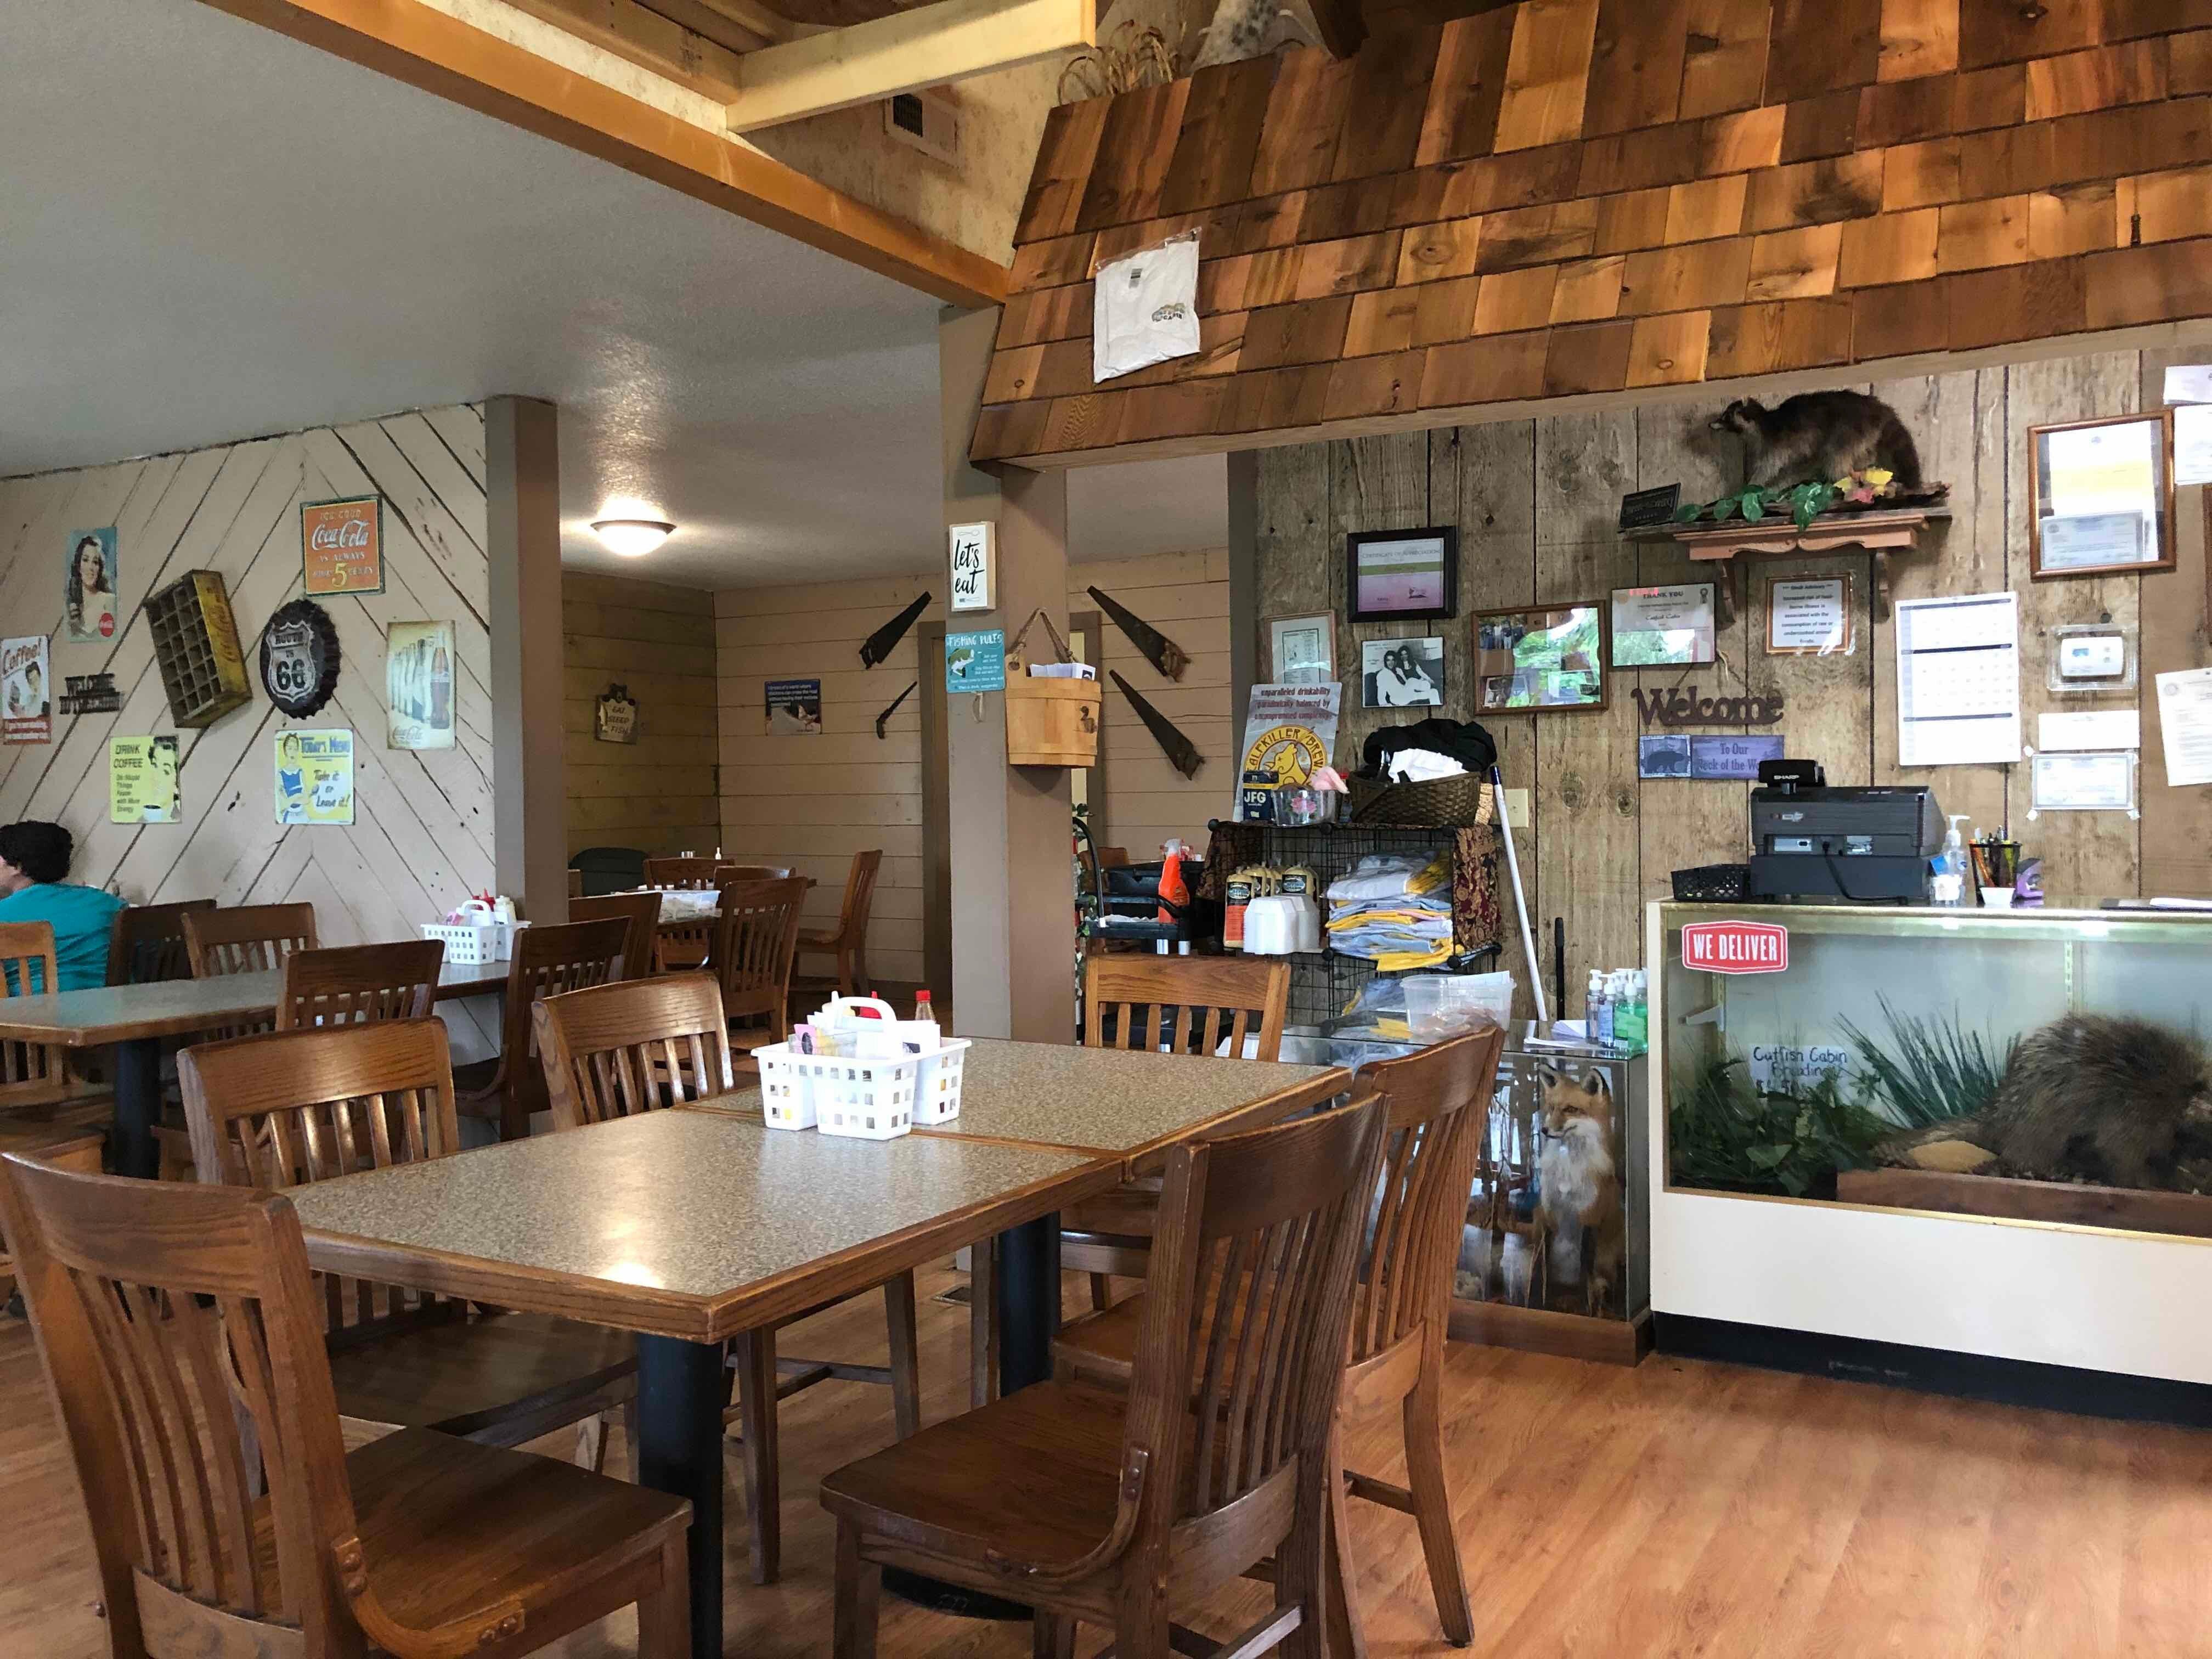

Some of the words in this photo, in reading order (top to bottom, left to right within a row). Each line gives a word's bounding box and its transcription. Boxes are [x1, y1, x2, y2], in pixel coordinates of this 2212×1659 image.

[312, 519, 370, 551] Coca-Cola
[333, 551, 365, 561] ALWAYS
[954, 538, 980, 571] let's
[331, 562, 347, 588] 5
[955, 568, 985, 594] eat
[947, 635, 977, 647] FISHING
[979, 633, 1002, 645] RULES
[276, 659, 306, 691] 66
[1261, 687, 1295, 697] unparalleled
[1298, 687, 1331, 697] drinkability
[1296, 698, 1321, 707] balanced
[1323, 698, 1331, 709] by
[1630, 686, 1784, 726] Welcome
[115, 744, 141, 755] DRINK
[1720, 743, 1730, 755] To
[1732, 742, 1749, 755] Our
[113, 758, 143, 768] COFFEE
[1720, 758, 1729, 770] of
[1731, 759, 1745, 771] the
[1244, 791, 1266, 804] JFG
[1693, 934, 1714, 960] WE
[1719, 934, 1778, 961] DELIVER
[1809, 1047, 1848, 1064] Cabin
